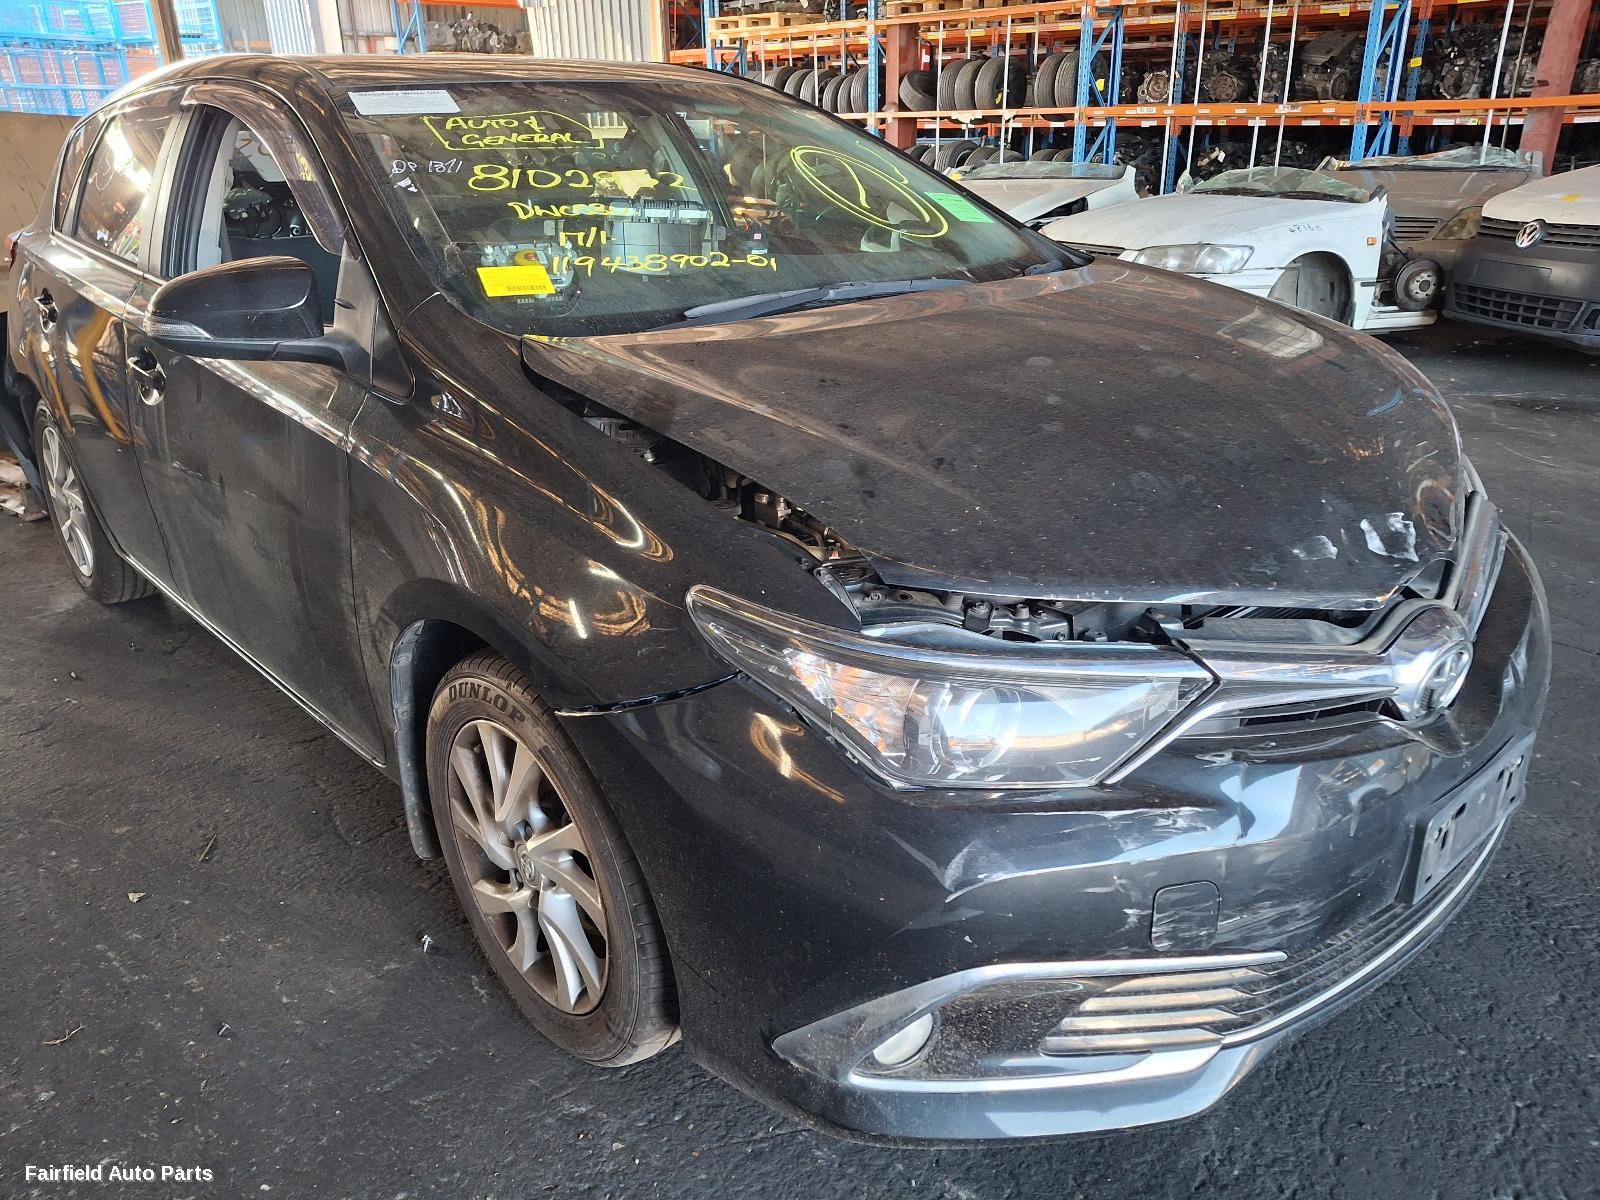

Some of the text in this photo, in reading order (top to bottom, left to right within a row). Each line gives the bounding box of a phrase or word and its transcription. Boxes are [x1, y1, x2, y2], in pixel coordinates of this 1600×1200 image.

[445, 117, 519, 130] AUTO
[461, 133, 590, 147] GENERAL
[448, 681, 526, 723] DUNLOP
